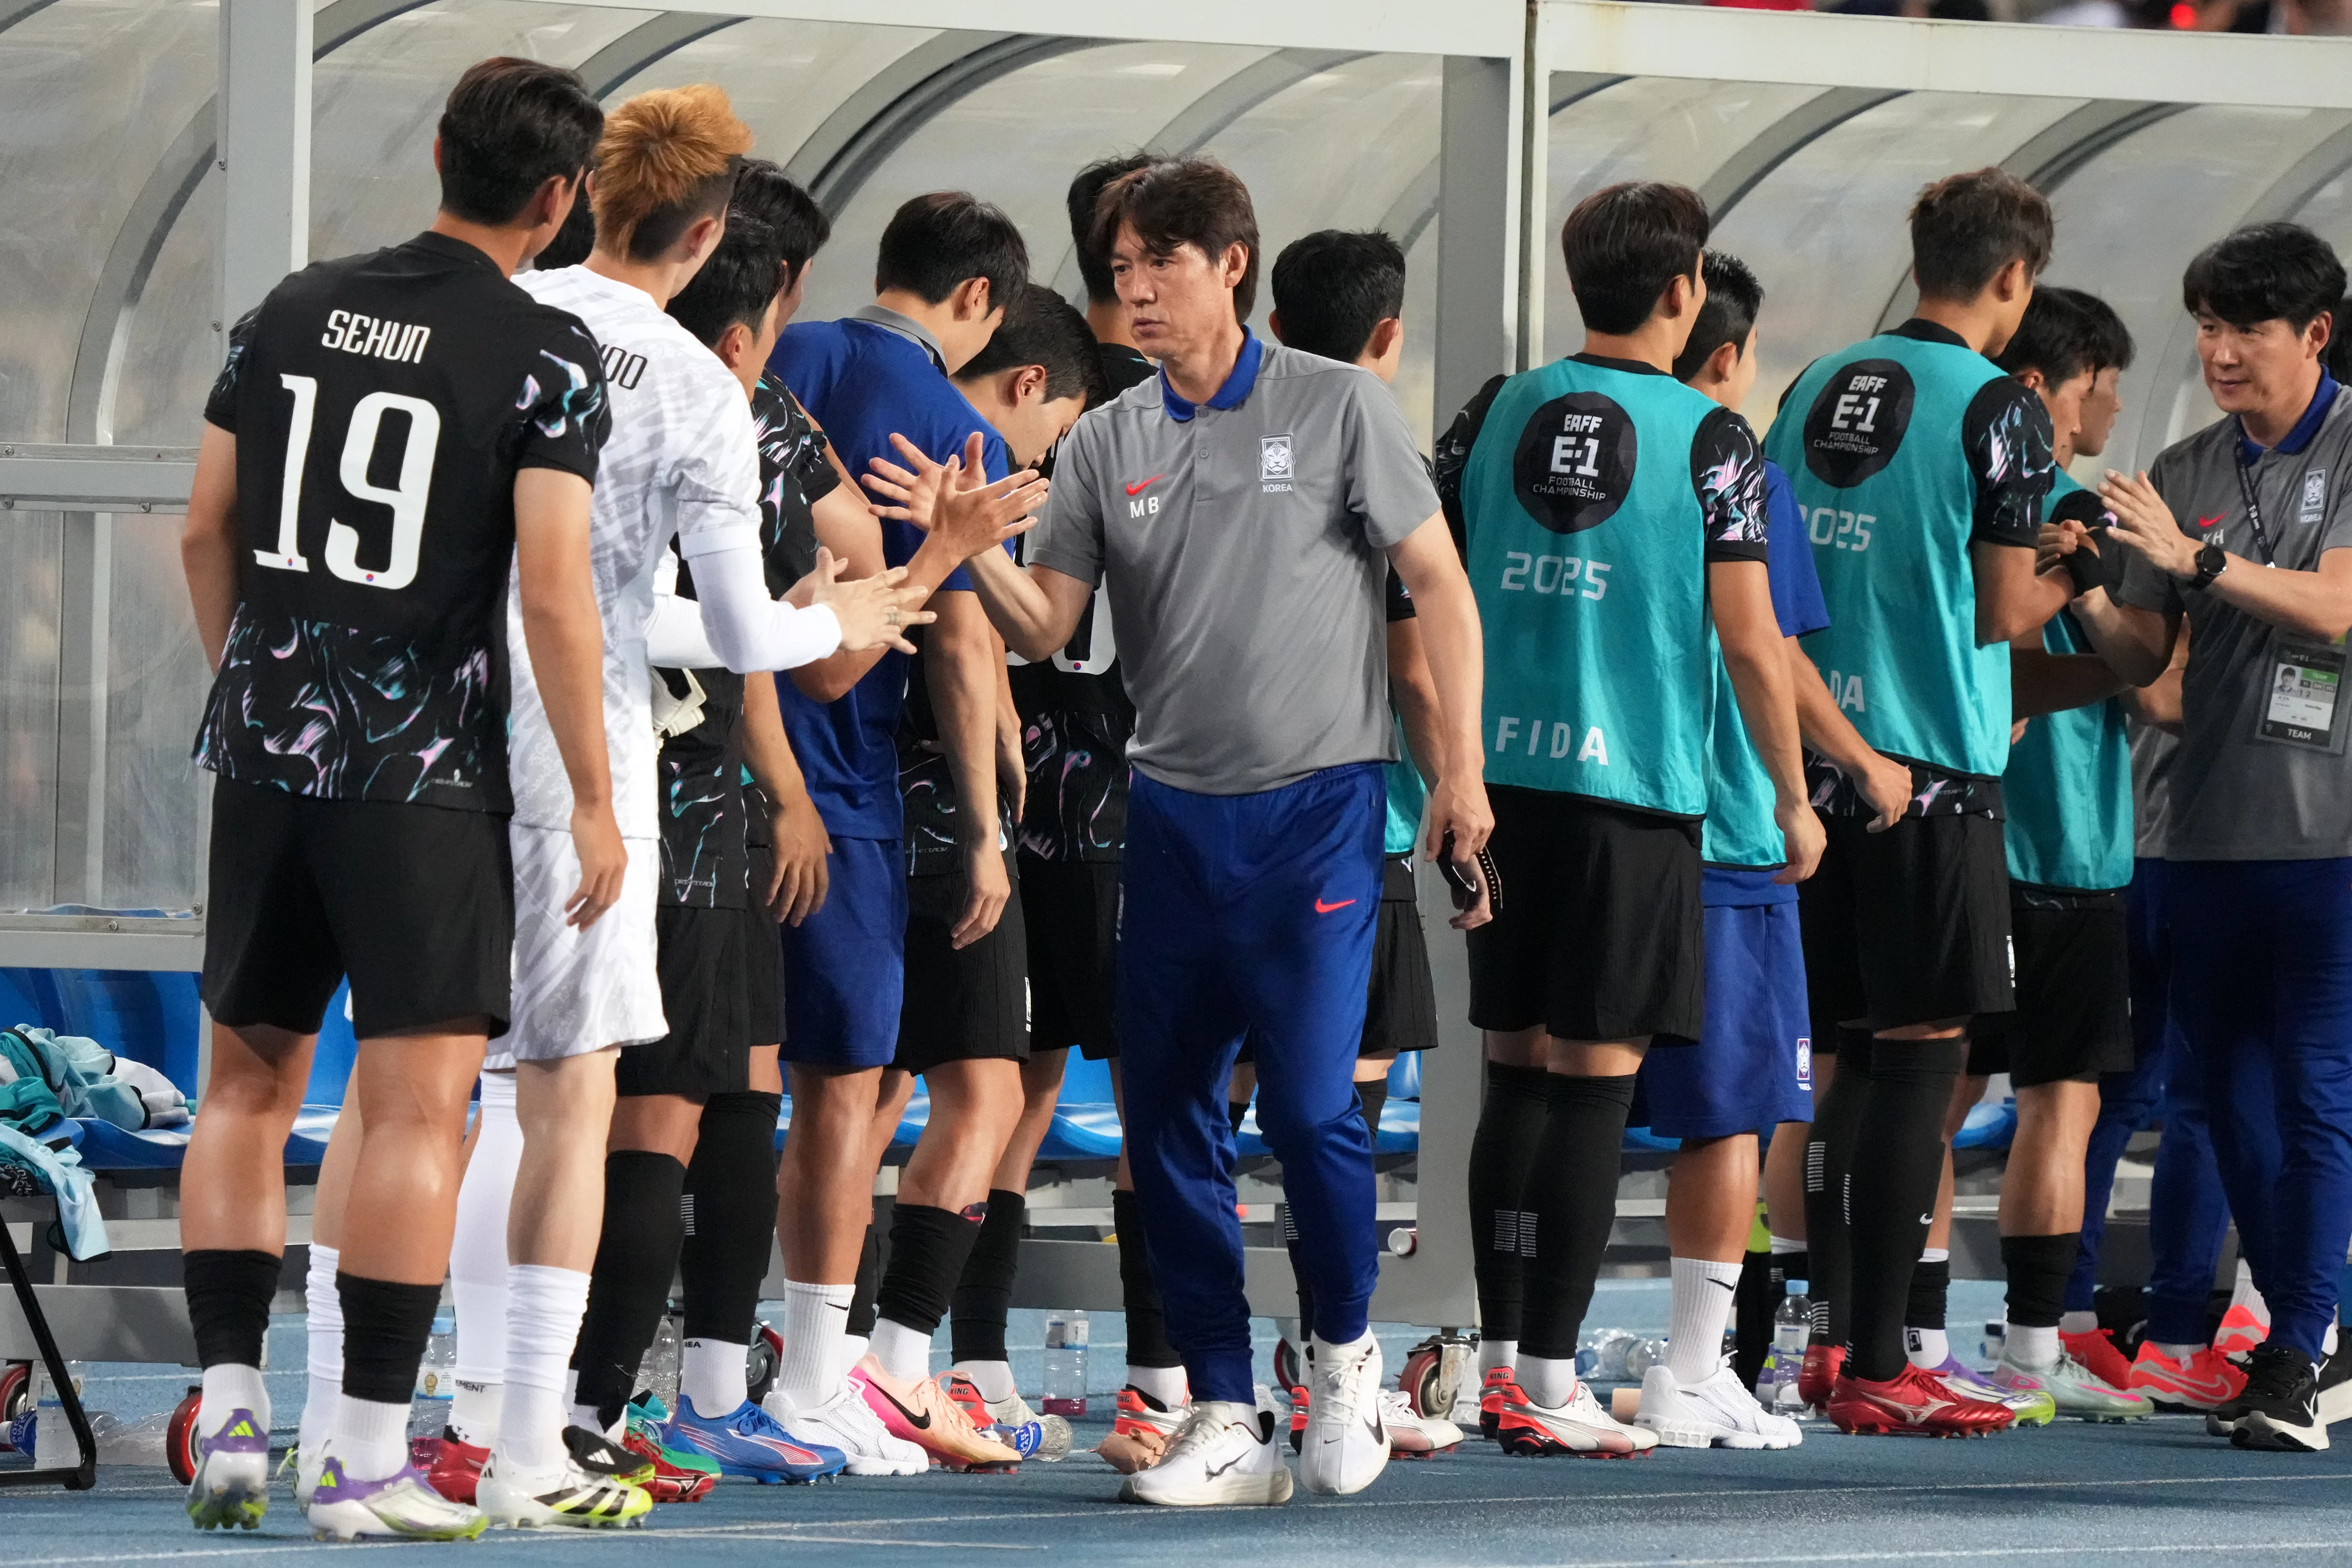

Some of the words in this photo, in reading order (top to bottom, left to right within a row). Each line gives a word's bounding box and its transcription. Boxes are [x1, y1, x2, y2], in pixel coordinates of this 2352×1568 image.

[322, 309, 431, 364] SEHUN
[1849, 375, 1888, 393] EAFF
[1832, 394, 1881, 433] E-1
[1563, 414, 1603, 433] EAFF
[1813, 439, 1879, 455] CHAMPIONSHIP
[1828, 432, 1871, 444] FOOTBALL
[1550, 435, 1600, 477] E-1
[253, 373, 440, 590] 19
[1263, 483, 1293, 493] KOREA
[1548, 476, 1596, 490] FOOTBALL
[1533, 484, 1606, 501] CHAMPIONSHIP
[1501, 551, 1612, 601] 2025
[1829, 670, 1865, 713] DA
[1495, 716, 1609, 766] FIDA
[2287, 728, 2312, 741] TEAM
